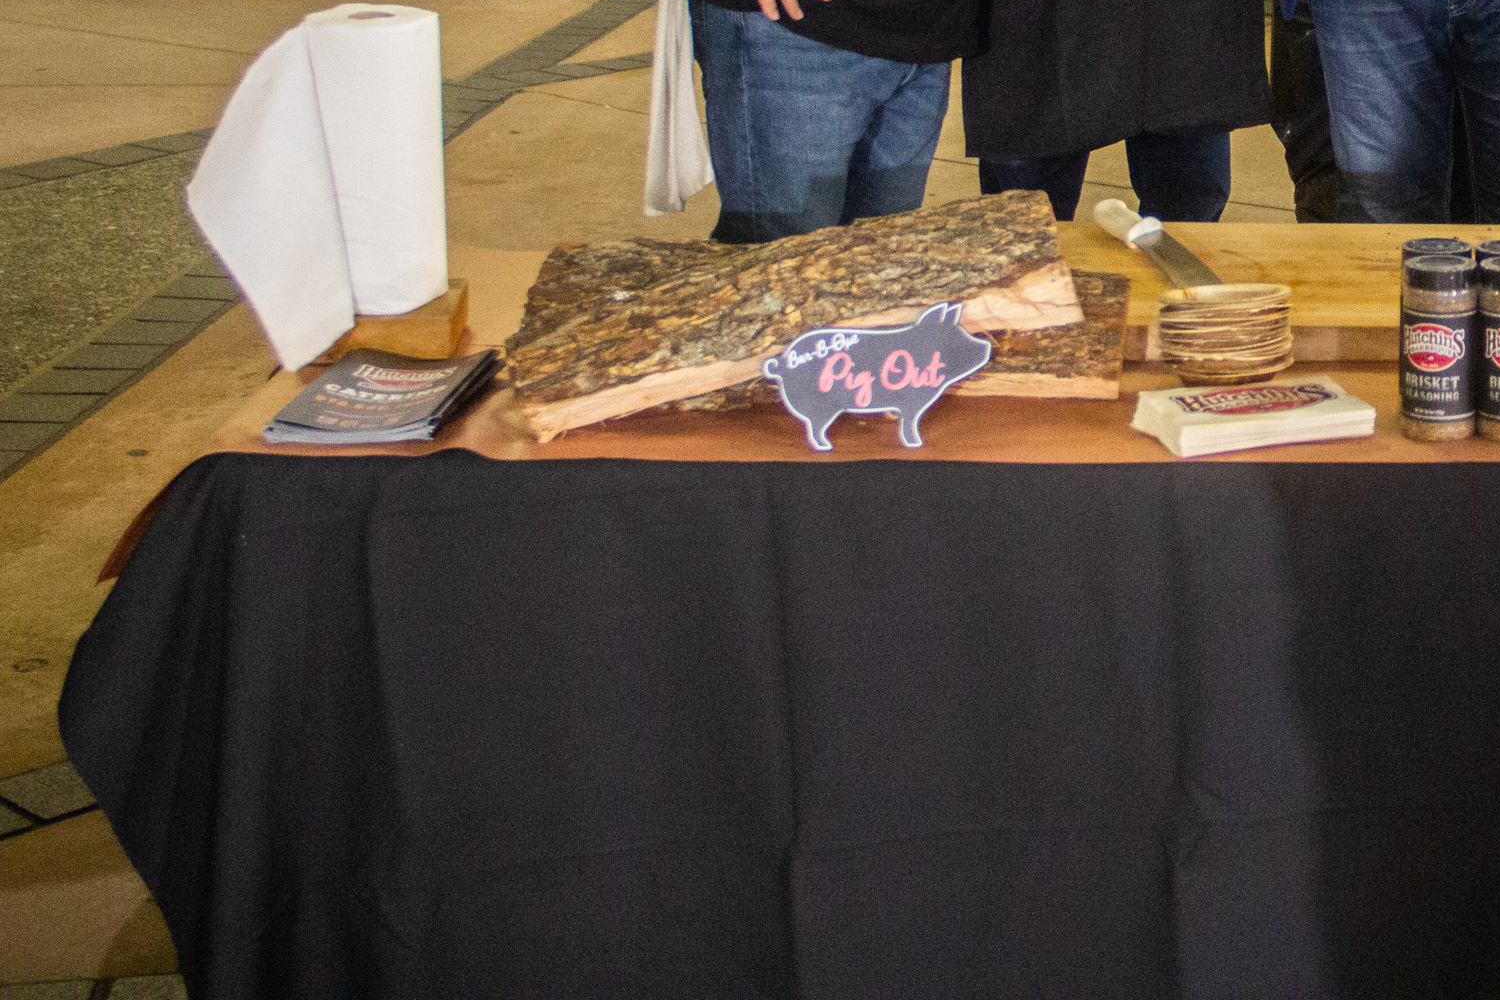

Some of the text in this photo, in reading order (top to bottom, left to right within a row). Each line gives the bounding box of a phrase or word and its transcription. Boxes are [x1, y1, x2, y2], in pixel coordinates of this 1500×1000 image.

[818, 349, 947, 408] Pig Out
[1405, 372, 1460, 390] BRISKET
